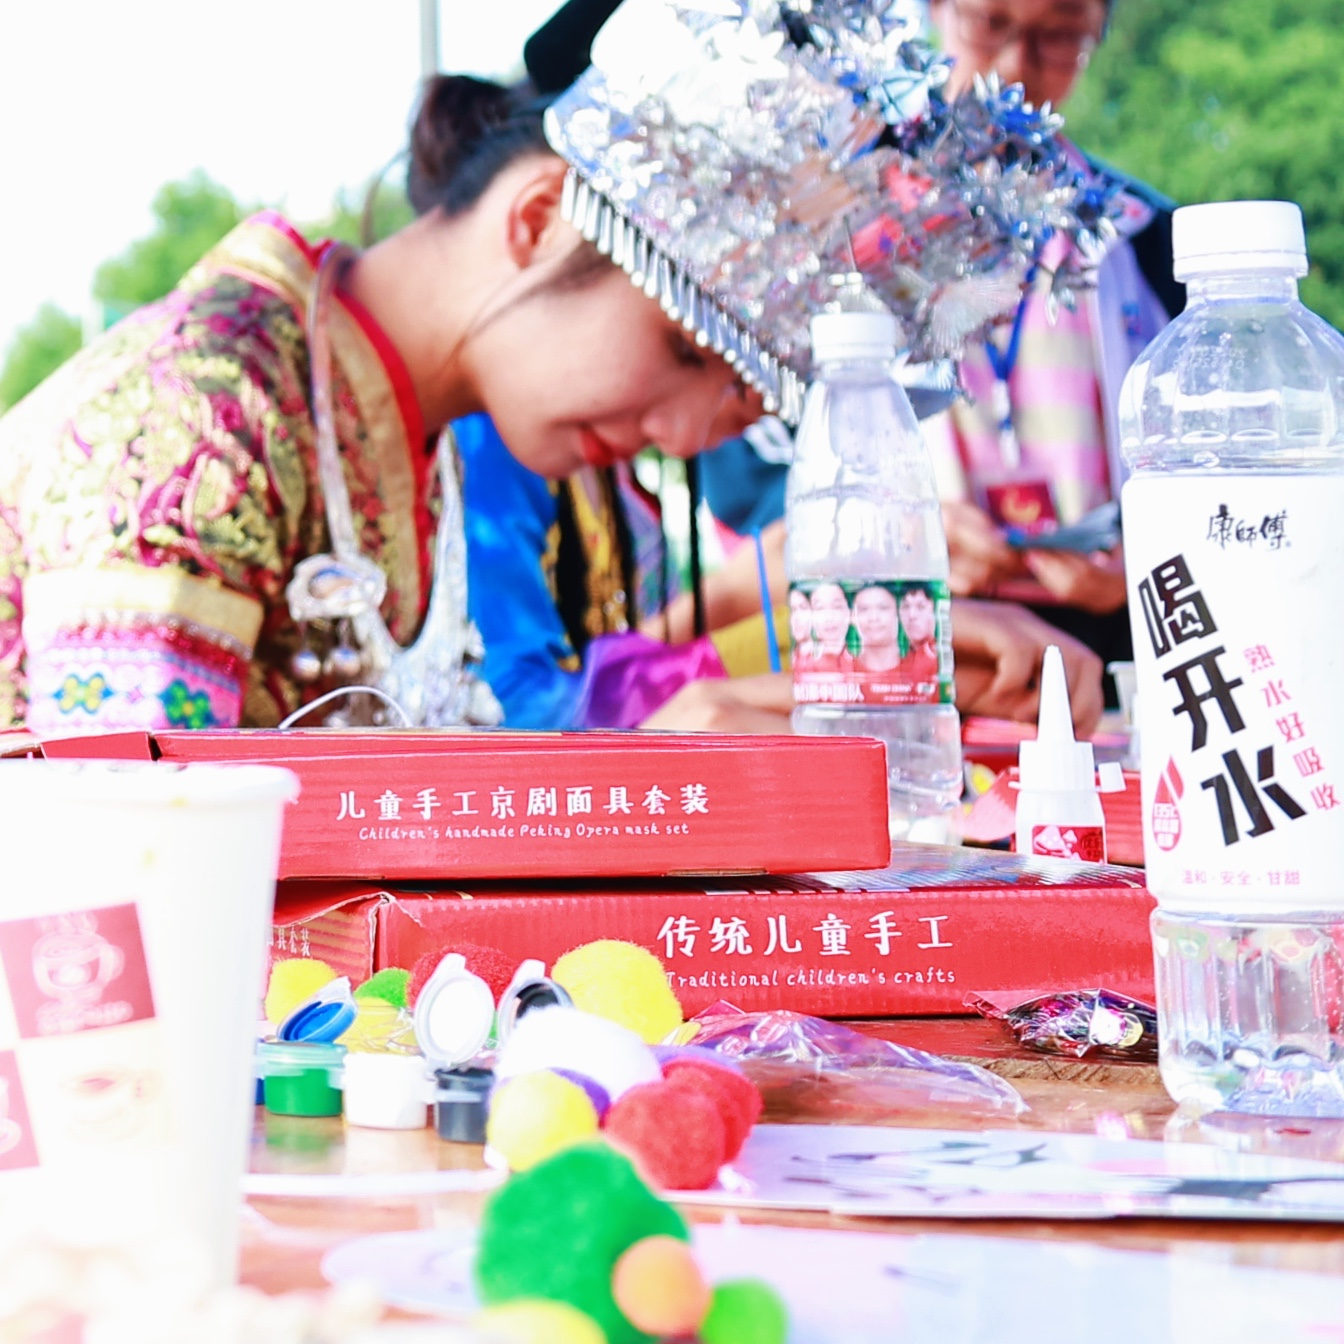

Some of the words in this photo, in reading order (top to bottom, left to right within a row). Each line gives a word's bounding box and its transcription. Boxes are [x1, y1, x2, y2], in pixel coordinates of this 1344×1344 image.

[1206, 503, 1288, 551] 康師傅
[1138, 553, 1308, 847] 喝开水
[336, 783, 710, 821] 儿童手工京剧面具套装
[359, 825, 440, 840] Children's
[445, 824, 515, 839] handmade
[520, 823, 572, 838] Peking
[575, 823, 620, 838] Opera
[625, 822, 661, 835] mask
[666, 822, 690, 835] set
[656, 910, 953, 958] 传统儿童手工
[786, 967, 886, 986] children's
[894, 966, 956, 984] crafts
